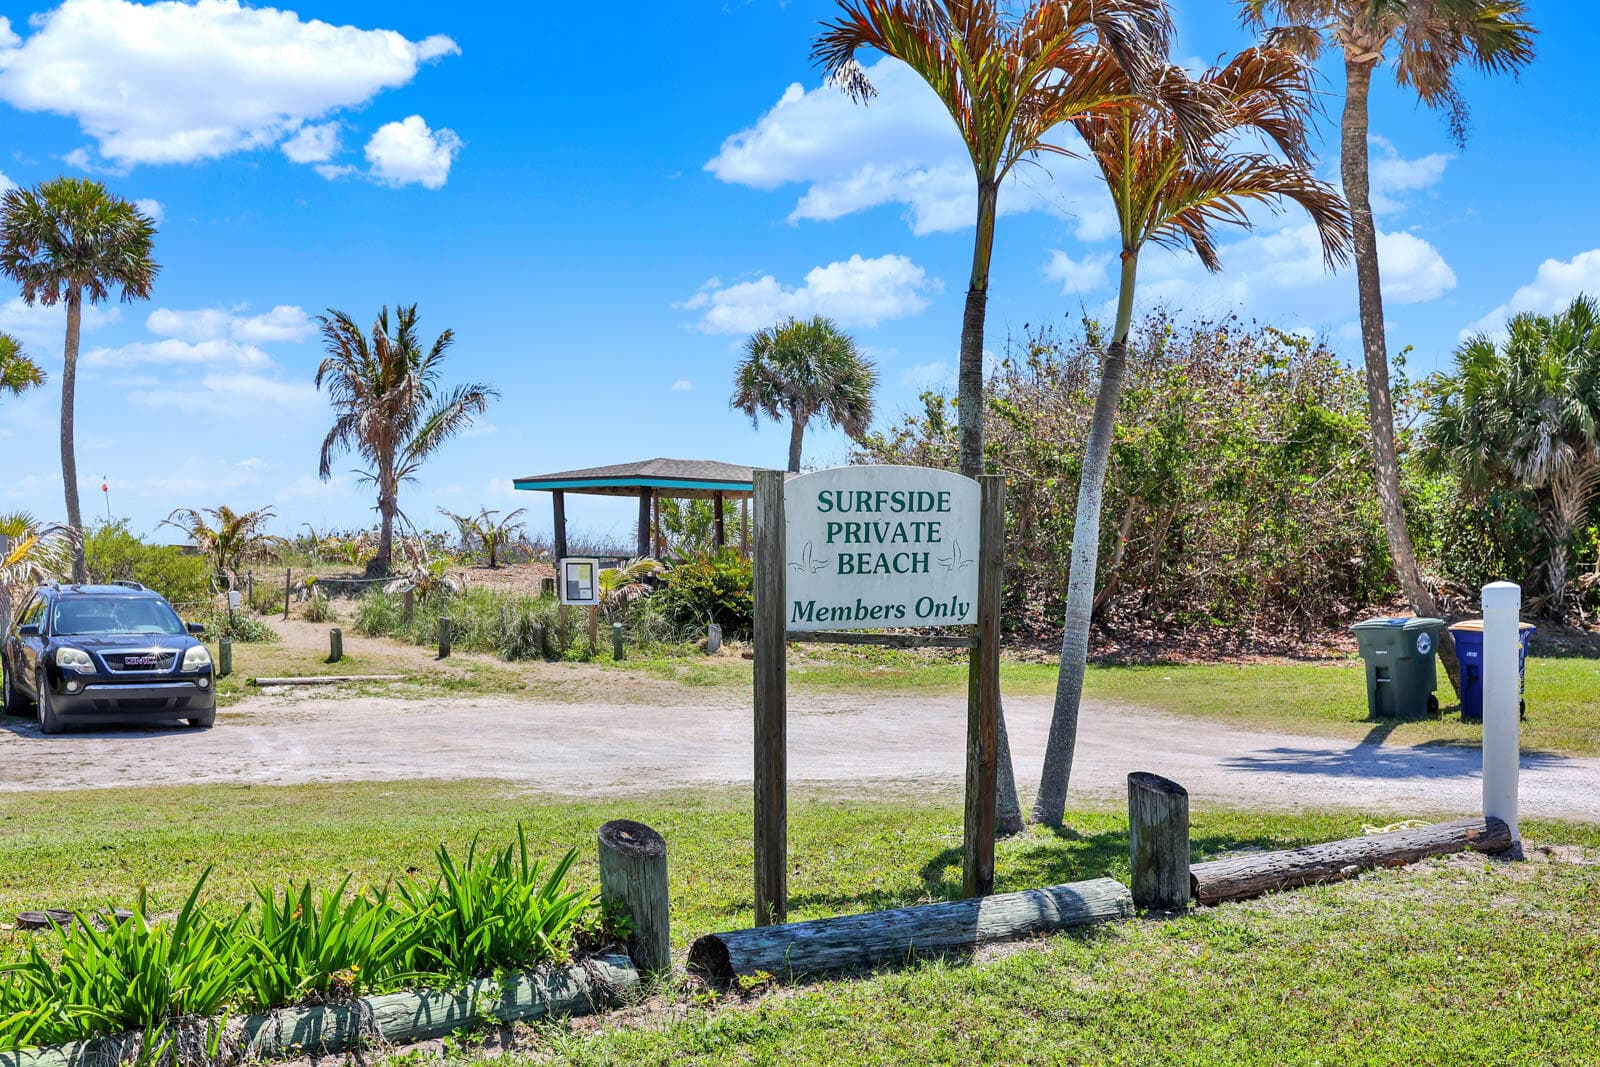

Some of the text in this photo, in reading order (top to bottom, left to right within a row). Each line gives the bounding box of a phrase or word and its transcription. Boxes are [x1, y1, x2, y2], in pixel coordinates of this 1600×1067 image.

[817, 490, 951, 513] SURFSIDE
[825, 521, 942, 544] PRIVATE
[837, 552, 930, 575] BEACH
[791, 595, 970, 623] Members Only
